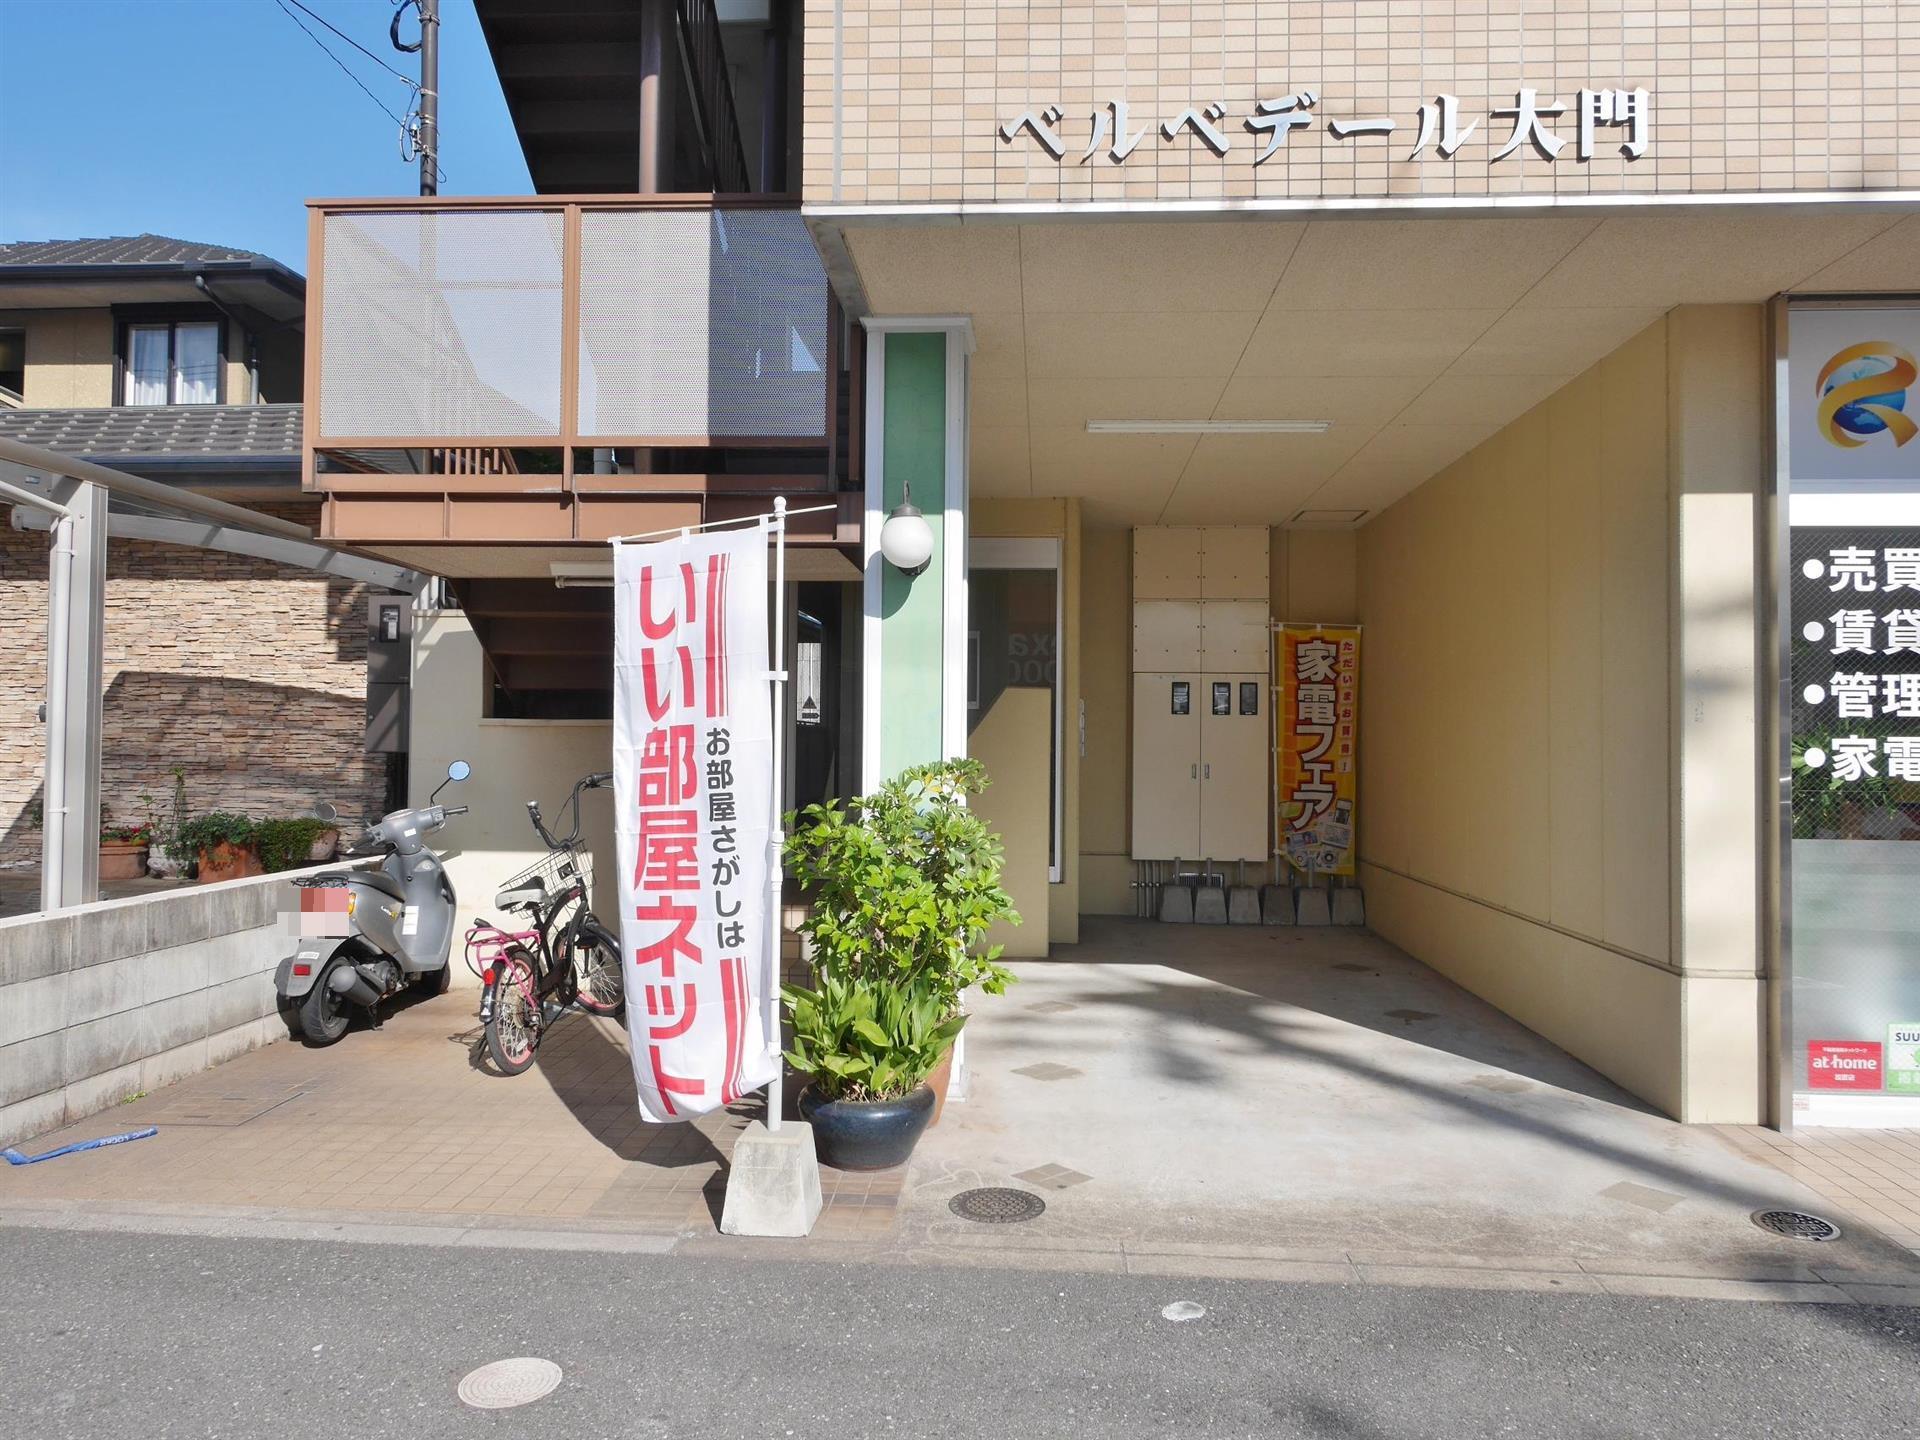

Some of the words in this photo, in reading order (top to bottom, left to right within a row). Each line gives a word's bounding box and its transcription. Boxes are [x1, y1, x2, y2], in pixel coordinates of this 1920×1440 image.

[999, 87, 1651, 167] ベルベデール大門
[1829, 546, 1920, 592] 売買
[1829, 609, 1920, 655] 賃貸
[1829, 671, 1920, 718] 管理
[1293, 640, 1337, 830] 家電フェア
[1831, 735, 1920, 782] 家電
[634, 562, 705, 1116] いい部屋ネット
[705, 727, 746, 949] お部屋さがしは
[1831, 1054, 1877, 1070] home
